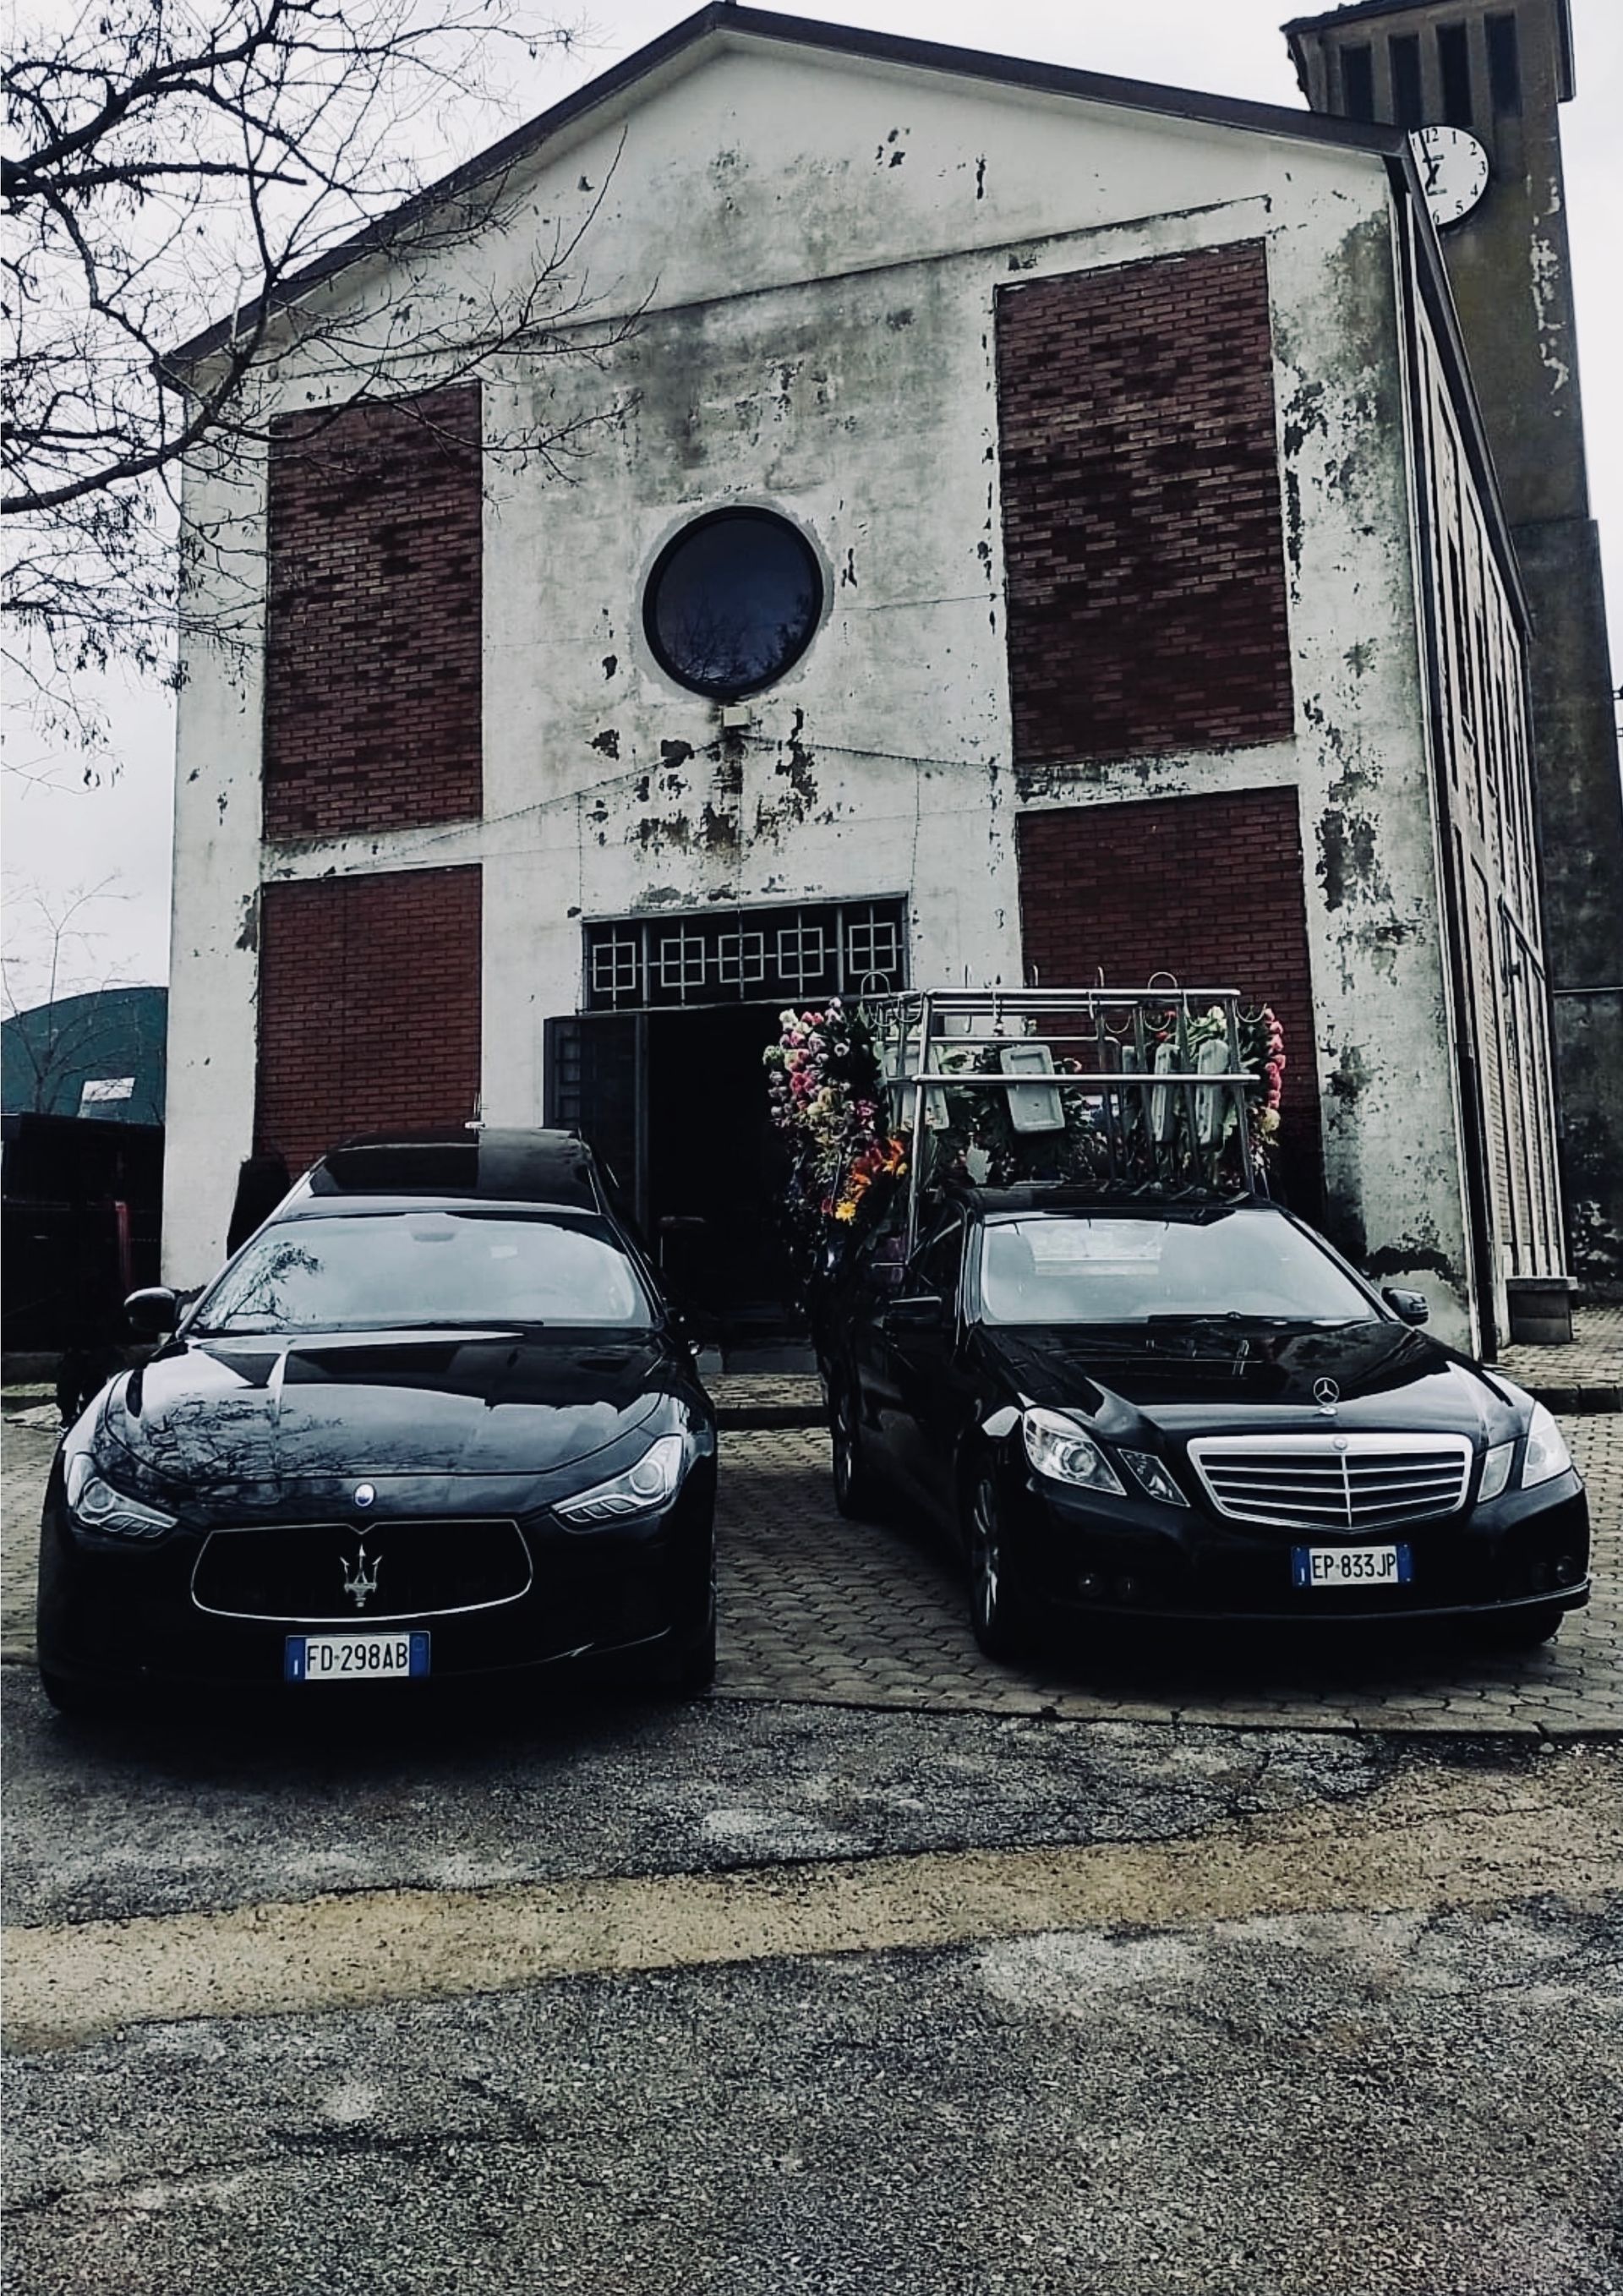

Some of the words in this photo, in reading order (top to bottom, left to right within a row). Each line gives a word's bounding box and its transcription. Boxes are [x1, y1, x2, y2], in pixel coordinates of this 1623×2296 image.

[1469, 141, 1477, 156] 2
[1478, 161, 1486, 176] 3
[1470, 183, 1478, 196] 4
[1456, 200, 1463, 215] 5
